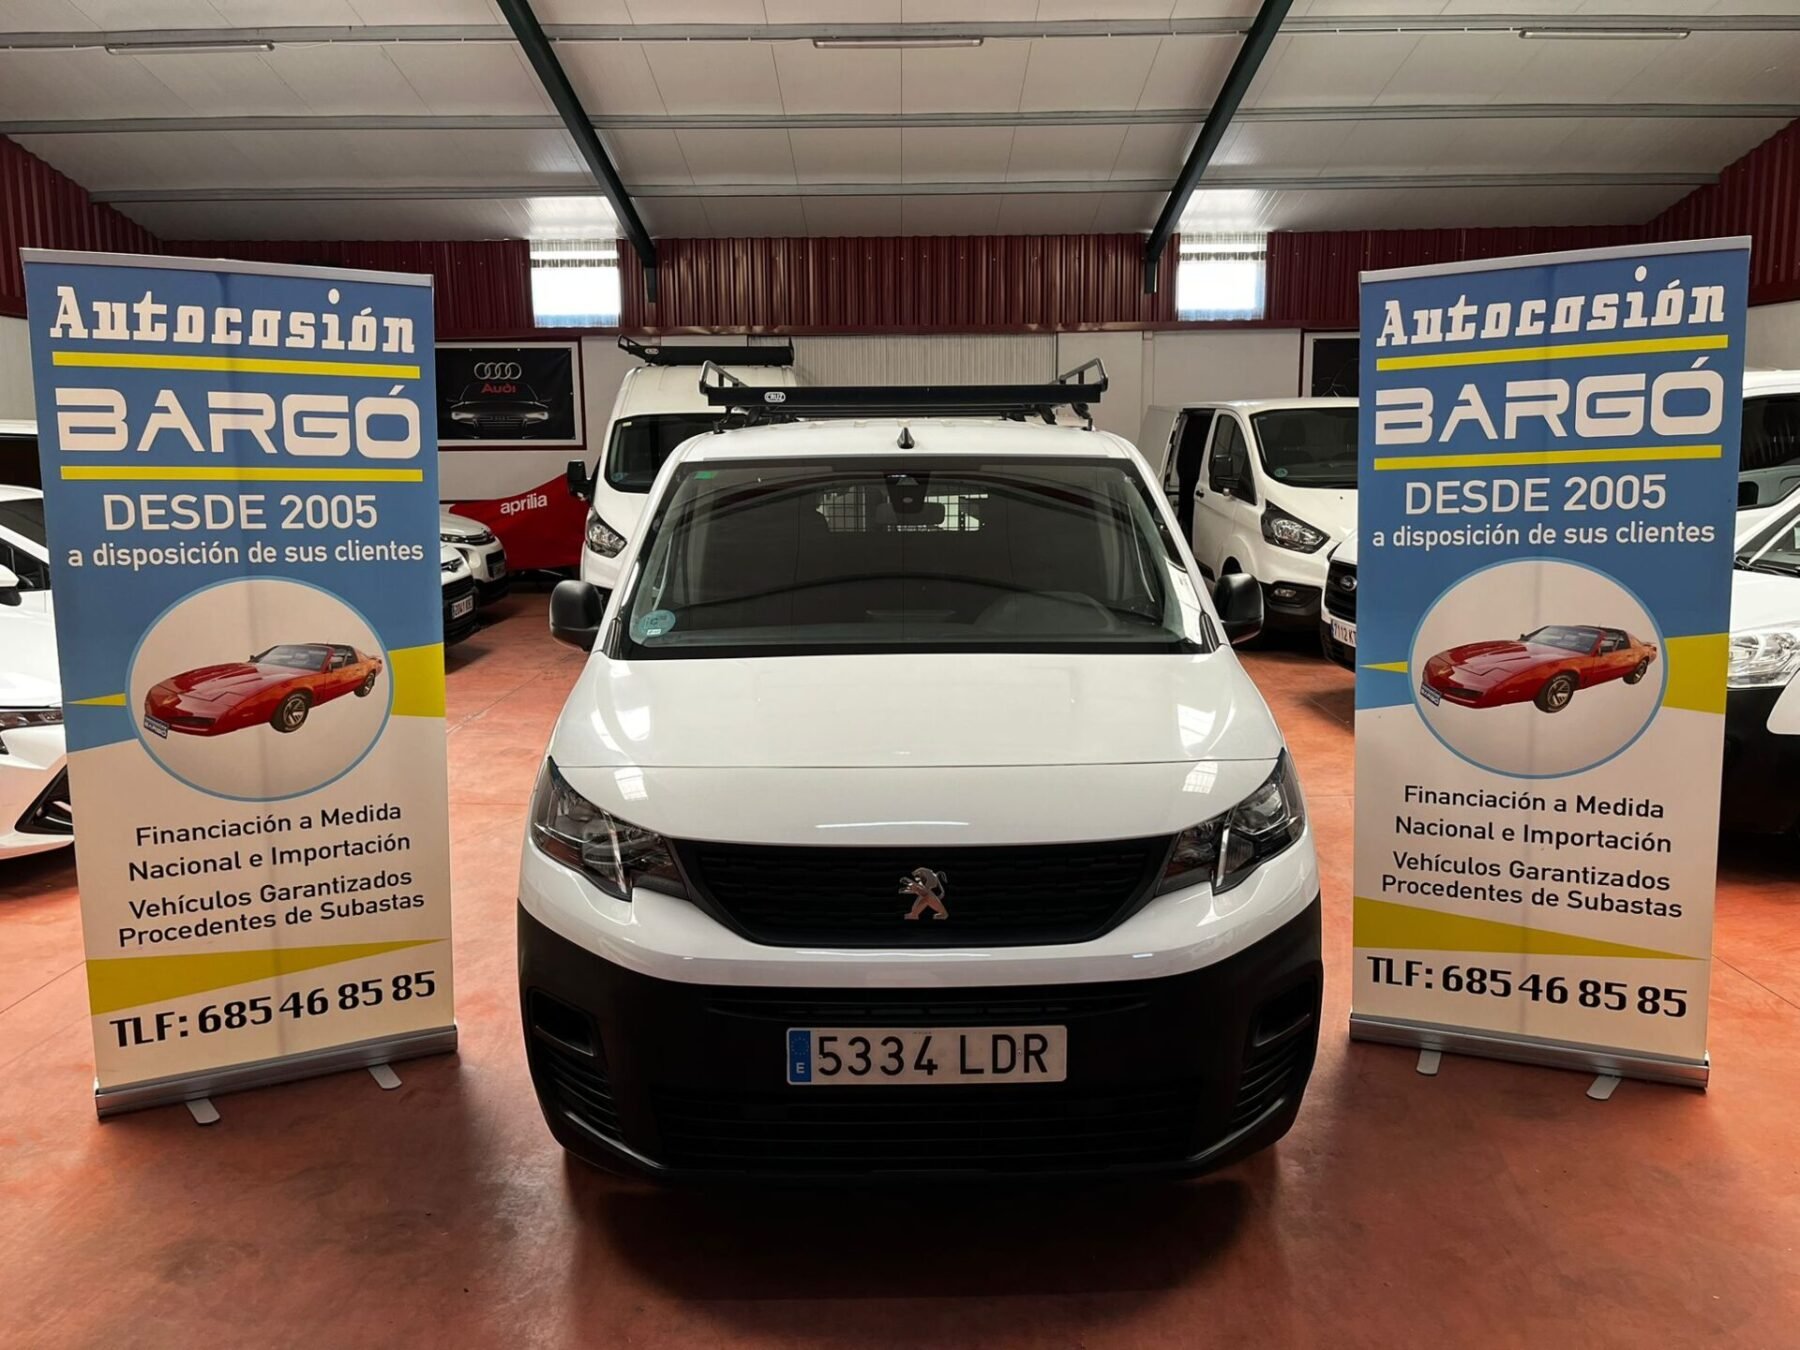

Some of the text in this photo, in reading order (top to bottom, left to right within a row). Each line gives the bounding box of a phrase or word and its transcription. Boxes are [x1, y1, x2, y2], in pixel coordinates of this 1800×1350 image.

[50, 286, 415, 353] Autocasión
[1376, 265, 1725, 346] Autocasión
[481, 383, 516, 393] Audi
[1375, 356, 1724, 445] BARGÓ
[55, 385, 421, 459] BARGÓ
[103, 494, 378, 531] DESDE 2005
[500, 493, 548, 515] aprilia
[1406, 474, 1667, 515] DESDE 2005
[68, 540, 424, 571] a disposición de sus clientes
[1372, 521, 1715, 551] a disposición de sus clientes
[1404, 785, 1664, 818] Financiación a Medida
[136, 804, 402, 846] Financiación a Medida
[1395, 816, 1672, 853] Nacional e Importación
[129, 834, 410, 881] Nacional e Importación
[1393, 851, 1670, 891] Vehículos Garantizados
[129, 870, 412, 919] Vehículos Garantizados
[1382, 875, 1683, 918] Procedentes de Subastas
[119, 892, 425, 947] Procedentes de Subastas
[1367, 956, 1687, 1018] TLF: 685 46 85 85
[110, 970, 436, 1048] TLF: 685 46 85 85
[796, 1033, 1048, 1076] E 5334 LDR
